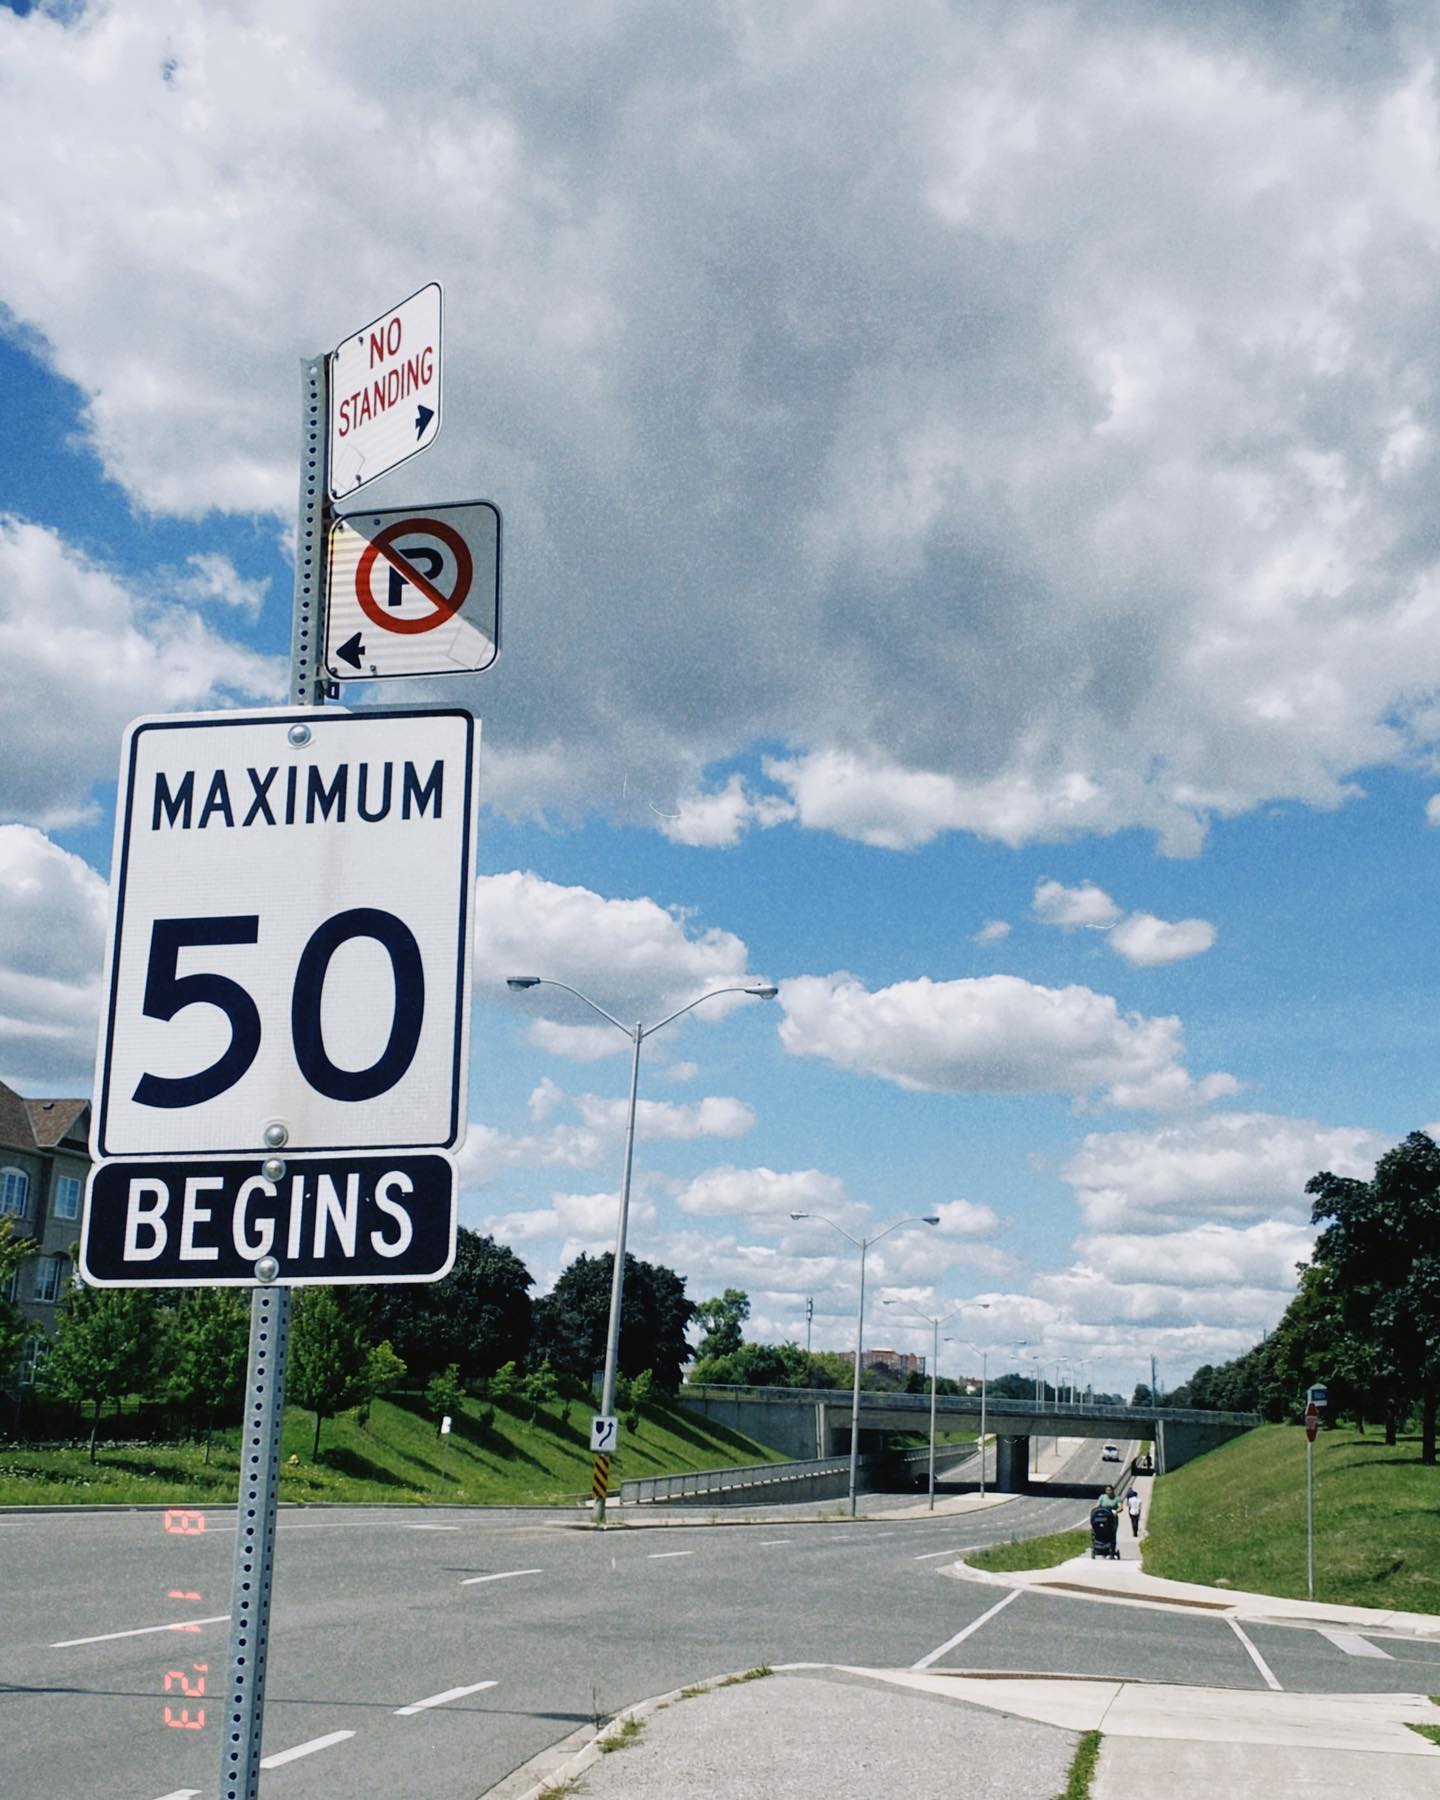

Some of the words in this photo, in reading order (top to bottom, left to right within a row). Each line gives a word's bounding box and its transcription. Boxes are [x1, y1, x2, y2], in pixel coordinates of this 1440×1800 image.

[369, 316, 402, 369] NO
[338, 345, 433, 437] STANDING
[387, 546, 444, 607] P
[152, 760, 445, 831] MAXIMUM
[131, 908, 426, 1109] 50
[123, 1170, 414, 1261] BEGINS
